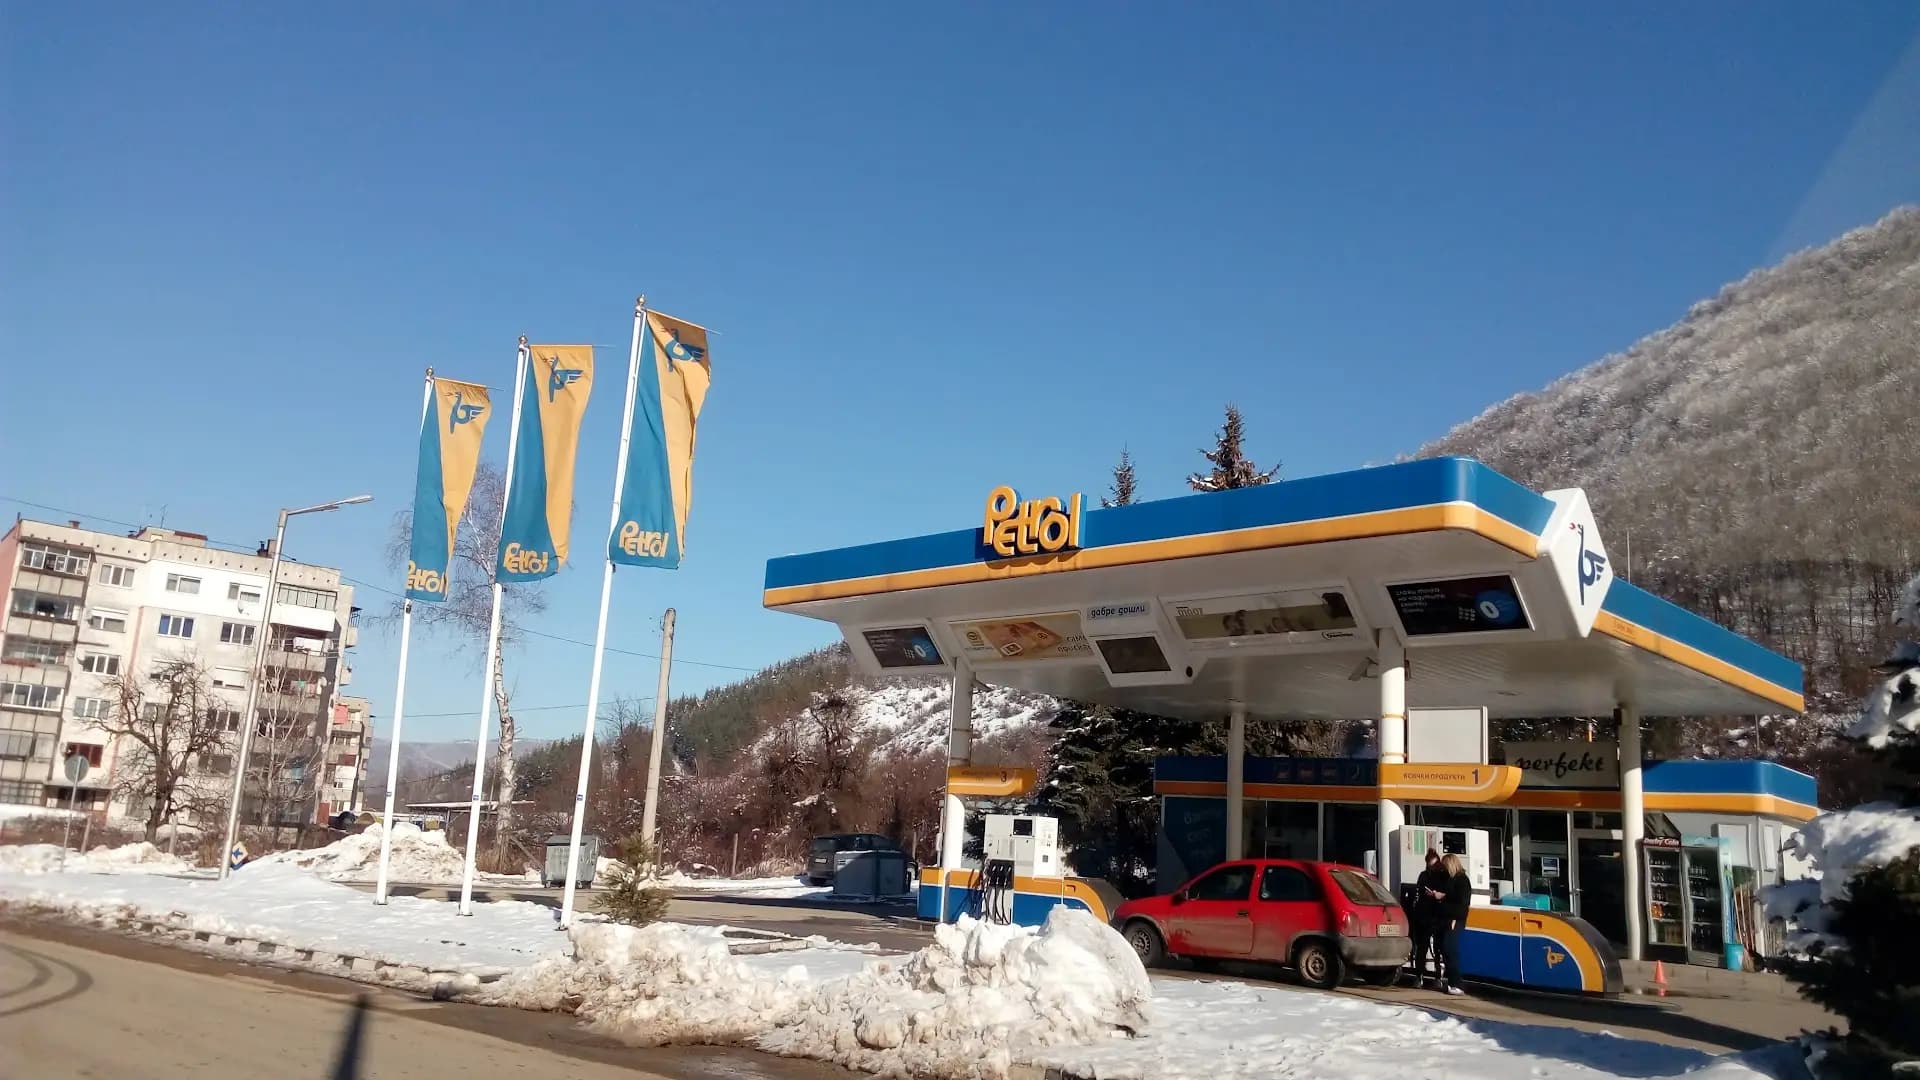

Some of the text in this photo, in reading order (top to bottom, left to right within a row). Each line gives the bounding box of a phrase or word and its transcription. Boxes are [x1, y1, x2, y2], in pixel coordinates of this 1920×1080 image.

[982, 485, 1082, 556] Petrol
[619, 520, 670, 558] Petrol
[503, 541, 549, 575] Petrol
[1471, 768, 1479, 785] 1
